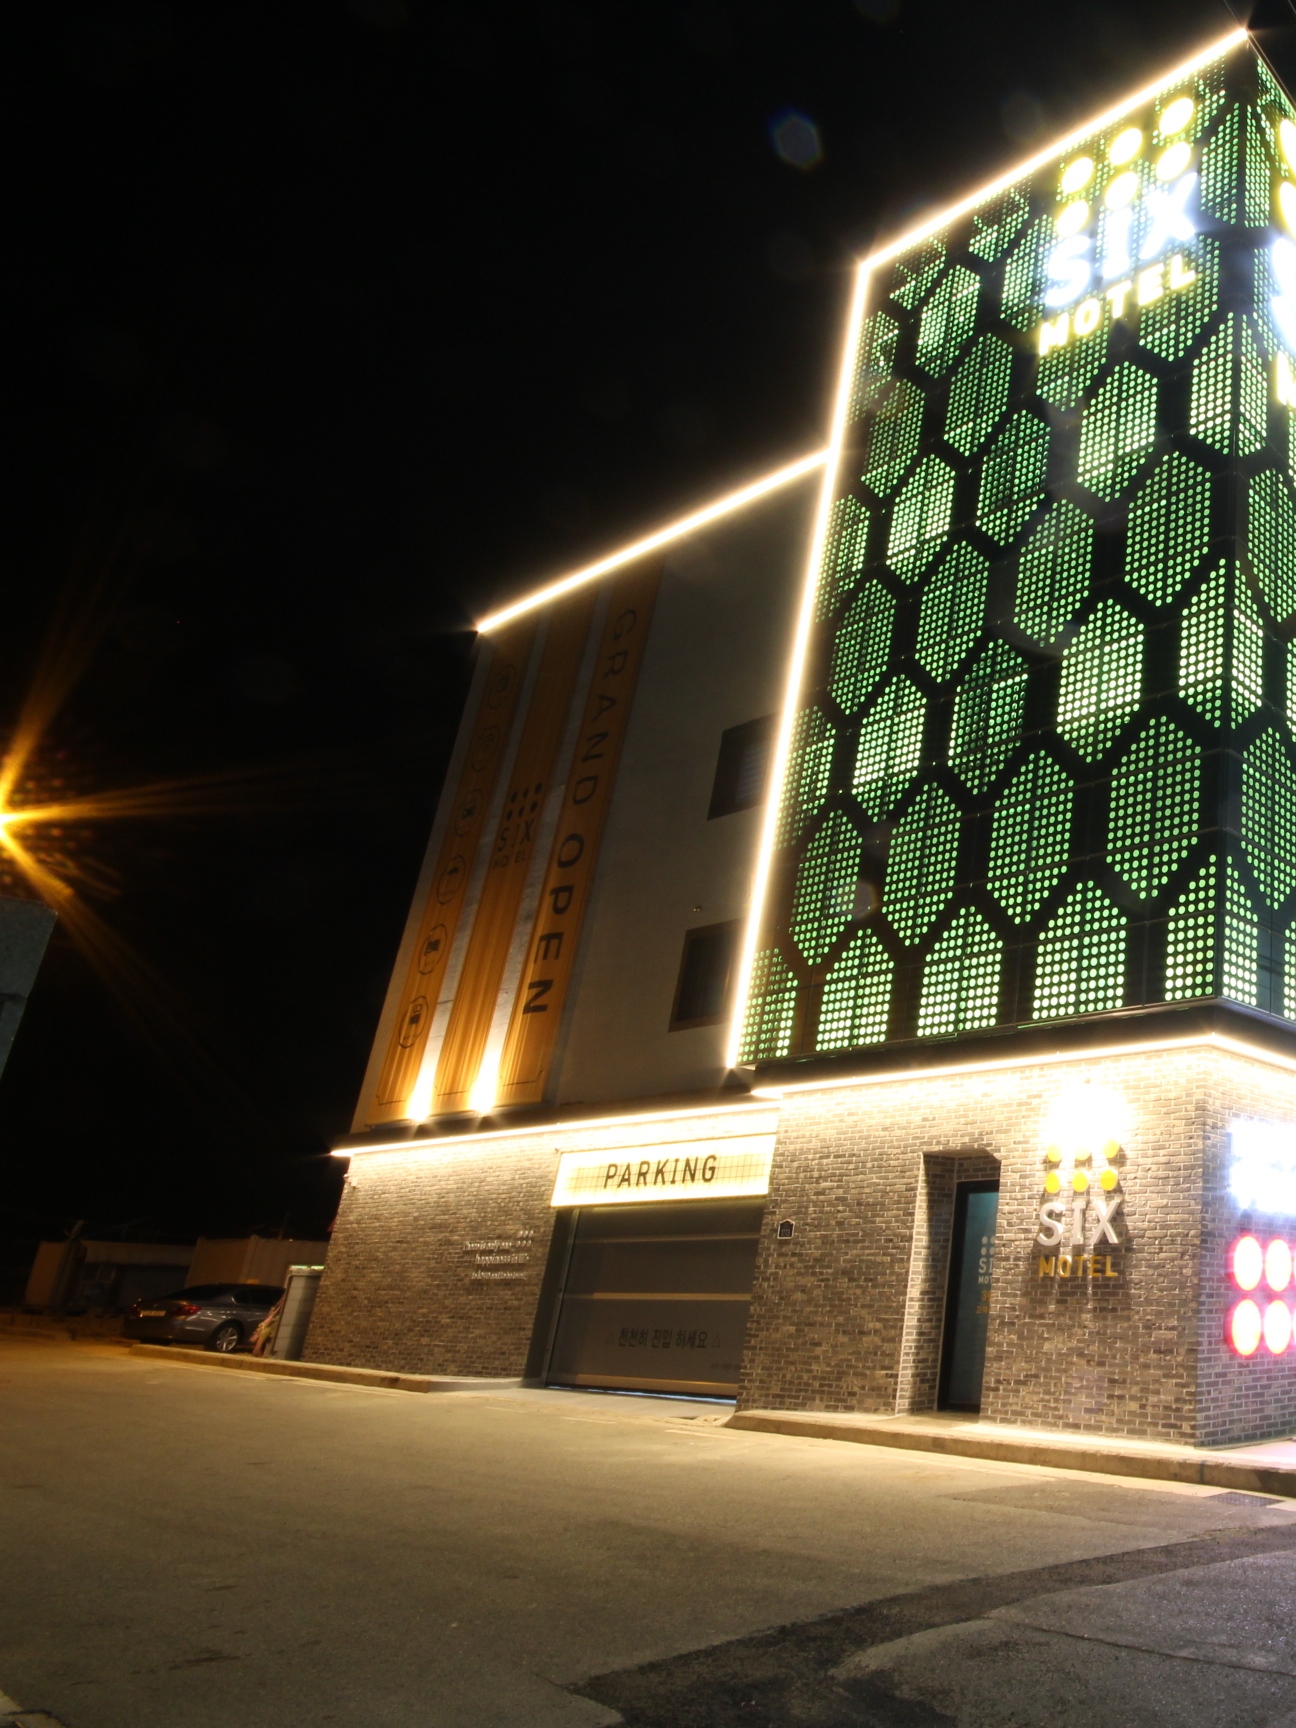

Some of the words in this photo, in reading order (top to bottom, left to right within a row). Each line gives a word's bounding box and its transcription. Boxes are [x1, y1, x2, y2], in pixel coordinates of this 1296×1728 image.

[1044, 171, 1198, 307] SIX
[1038, 254, 1197, 356] MOTEL
[572, 608, 637, 805] GRAND
[523, 832, 584, 1014] OPEN
[604, 1155, 717, 1188] PARKING
[1037, 1200, 1121, 1246] SIX
[1039, 1255, 1118, 1277] MOTEL
[619, 1327, 649, 1347] 천천히
[652, 1329, 672, 1349] 진입
[676, 1330, 708, 1349] 하세요
